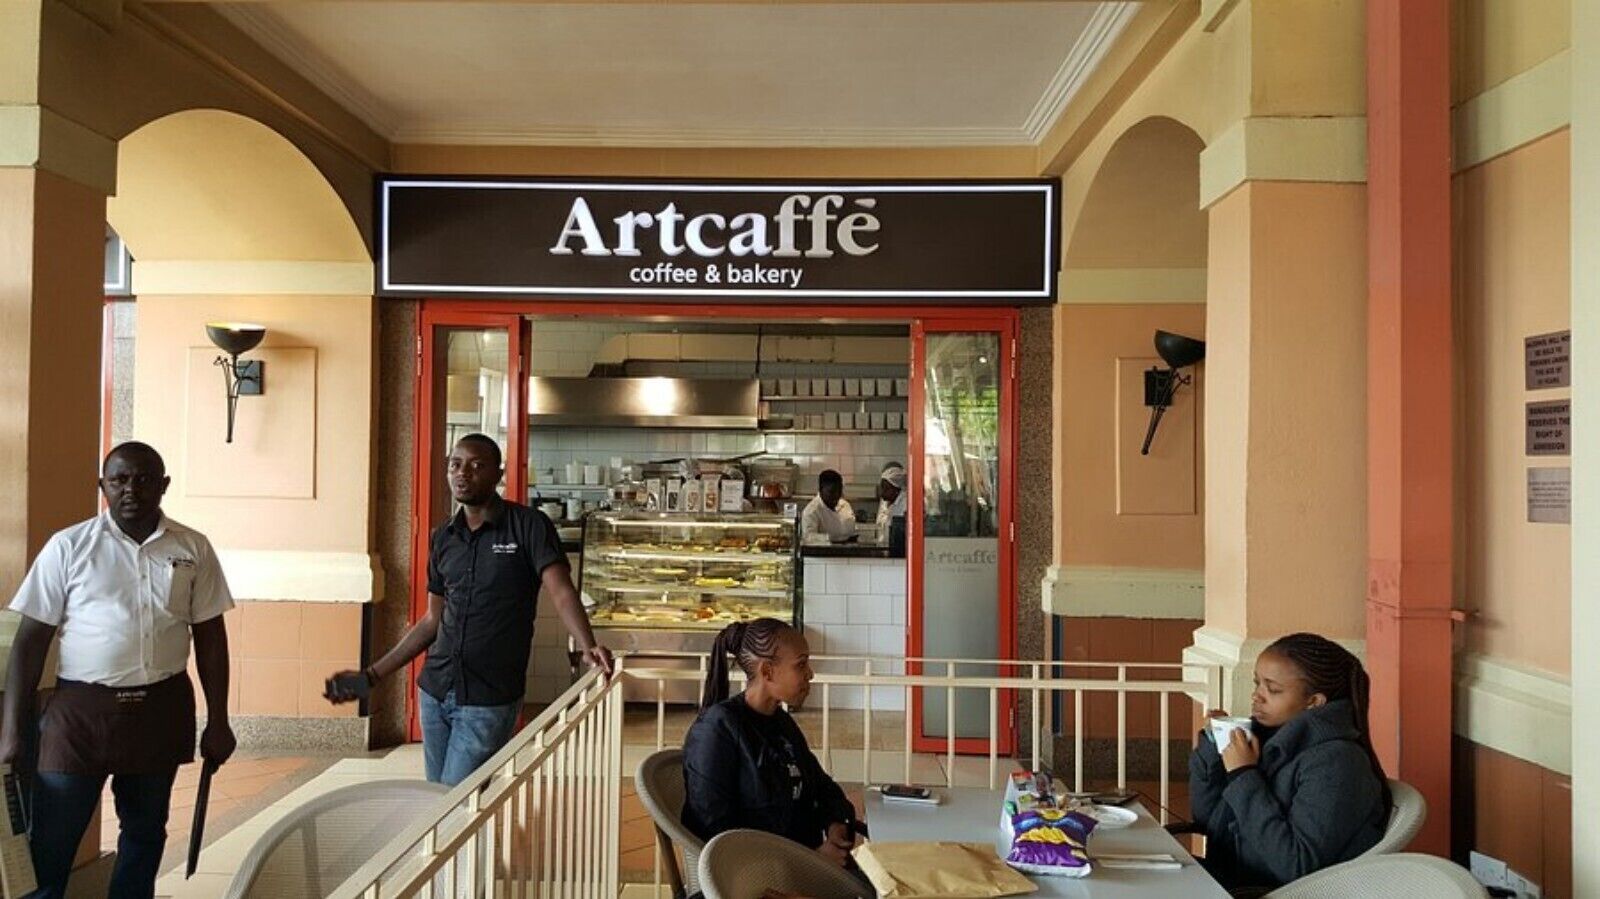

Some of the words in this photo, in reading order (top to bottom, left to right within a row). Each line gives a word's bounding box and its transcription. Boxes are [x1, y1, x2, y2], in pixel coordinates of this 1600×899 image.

[549, 195, 881, 258] Artcaffé
[629, 263, 698, 283] coffee
[704, 263, 721, 283] &
[727, 263, 803, 288] bakery
